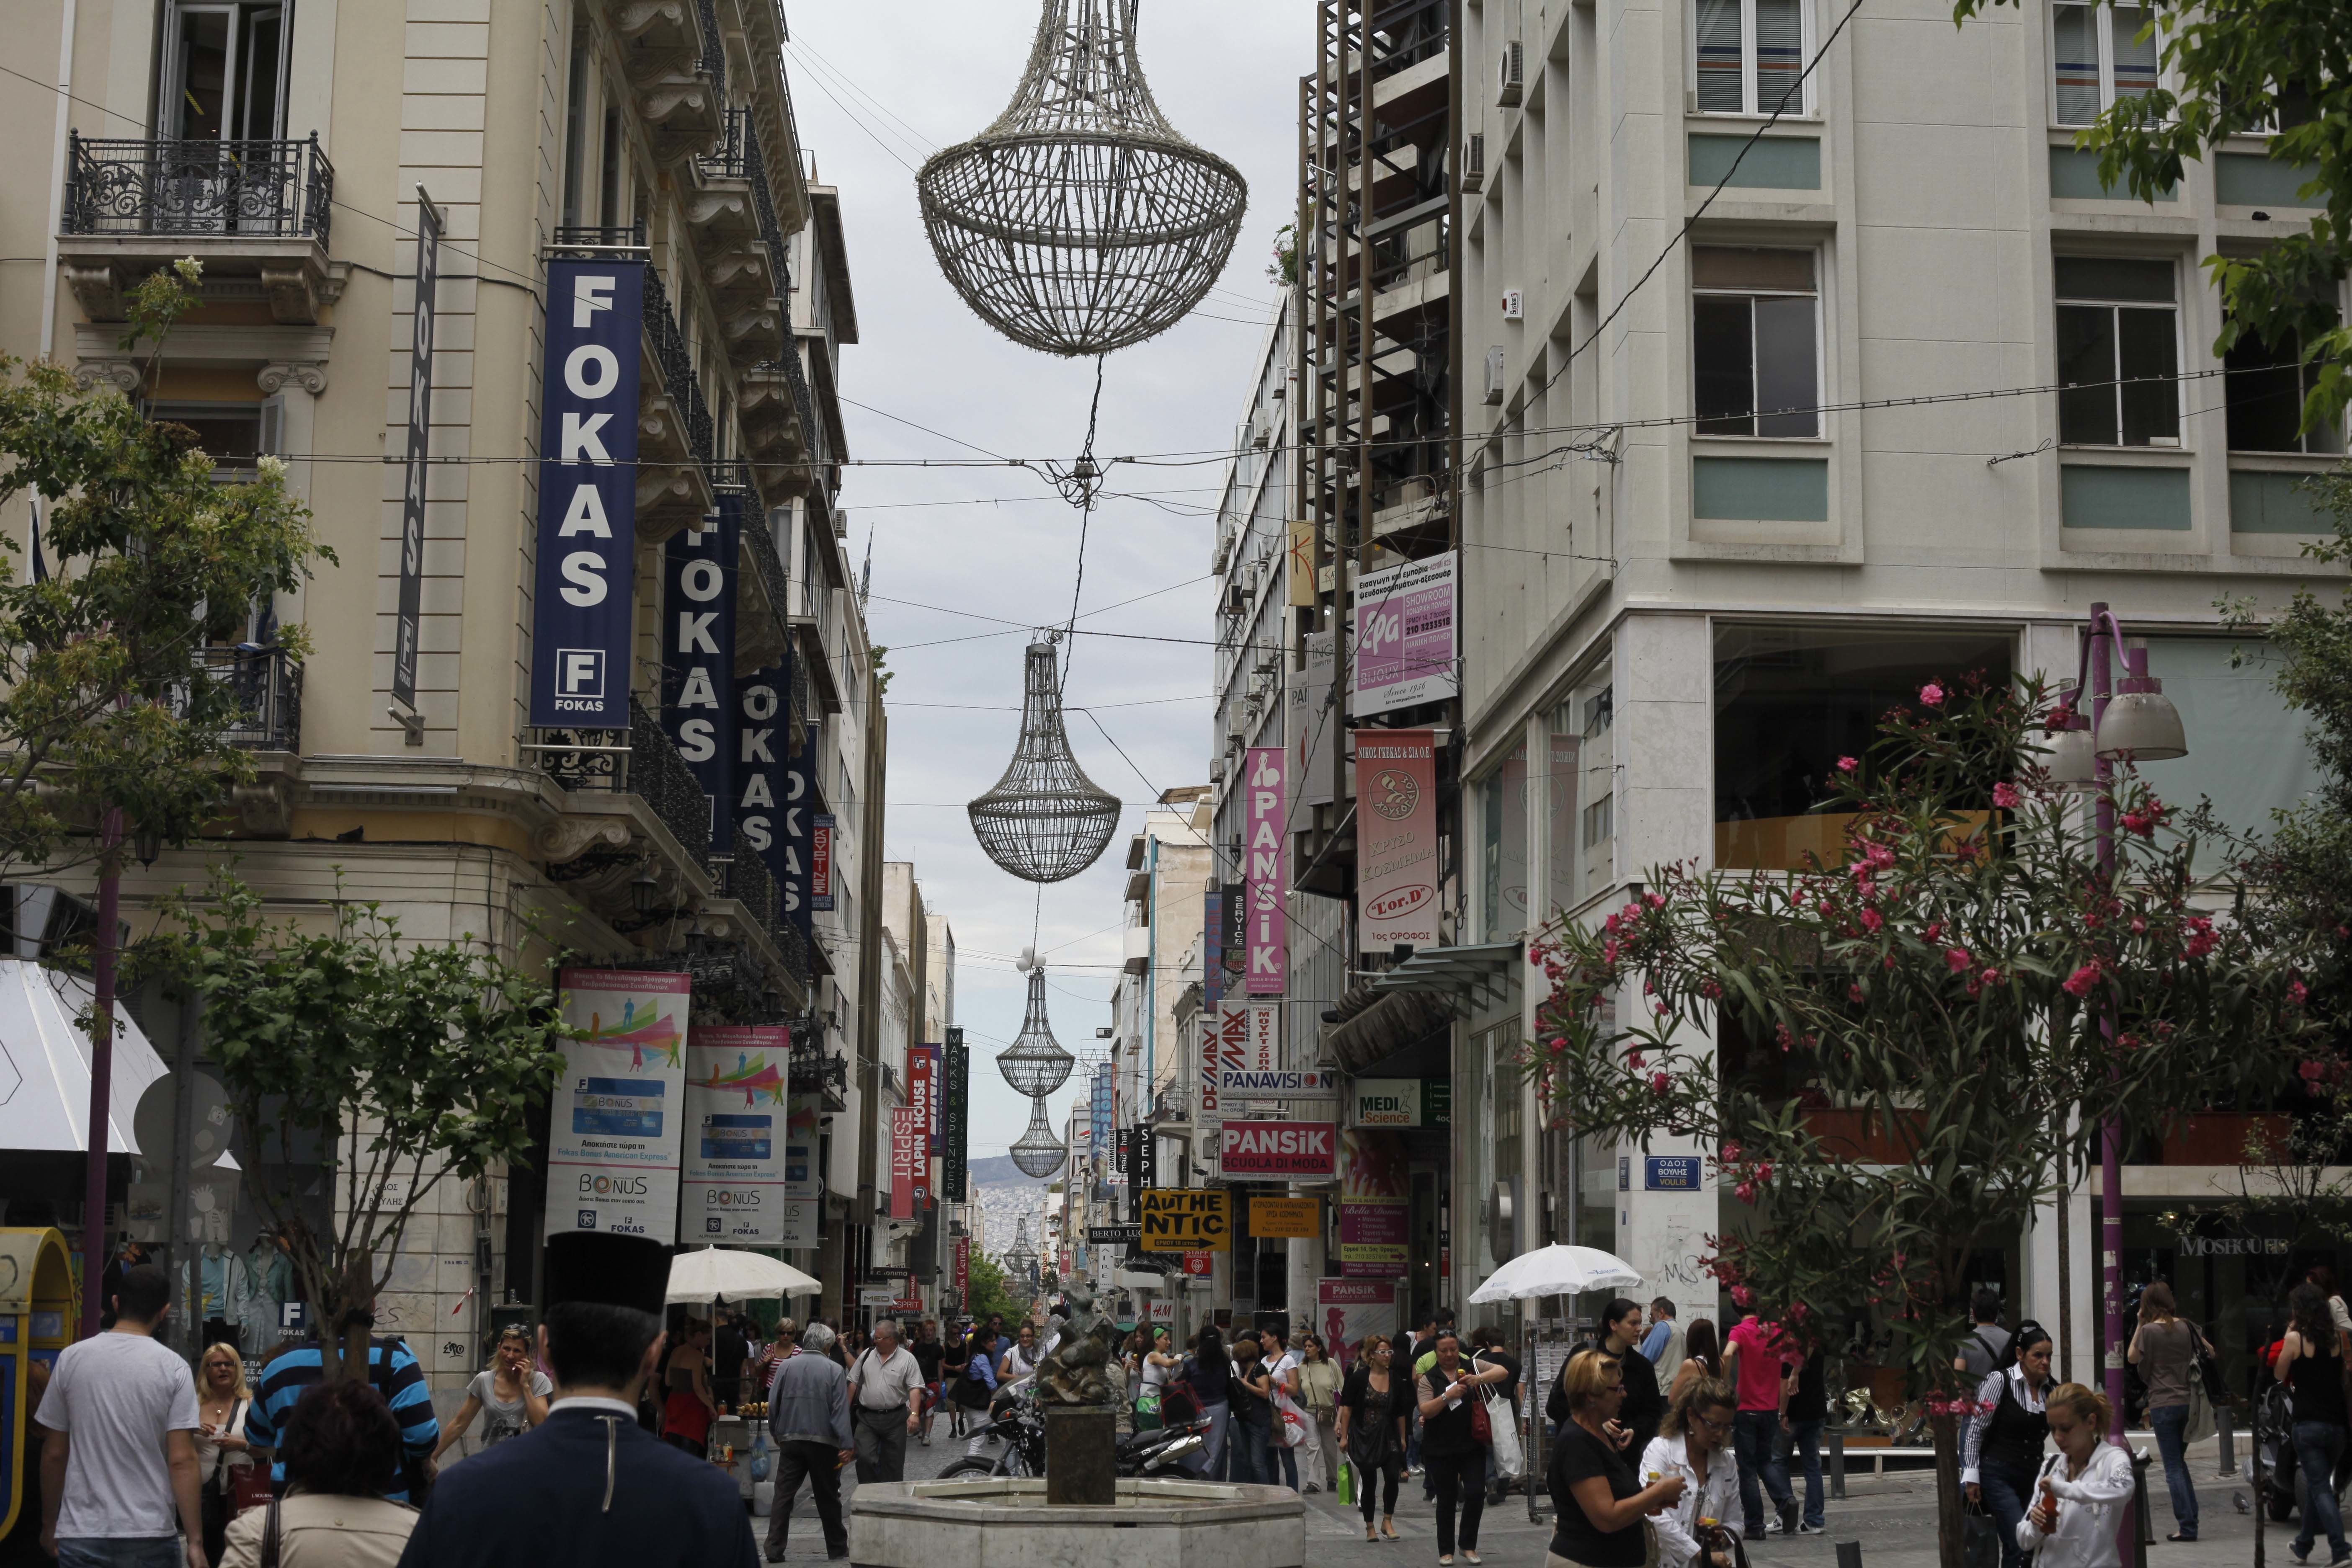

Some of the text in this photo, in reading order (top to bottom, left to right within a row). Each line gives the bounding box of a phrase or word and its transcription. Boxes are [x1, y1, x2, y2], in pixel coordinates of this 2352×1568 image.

[407, 226, 432, 576] FOKAS
[558, 275, 619, 607] FOKAS
[1359, 575, 1390, 589] Εισαγωγή
[1403, 566, 1428, 580] εμπορία
[1406, 586, 1450, 609] SHOWROOM
[1406, 599, 1451, 617] ΧΟΝΔΡΙΚΗ ΠΩΛΗΣΗ
[1406, 616, 1421, 625] ΕΡΜΟΥ
[1406, 617, 1451, 635] 210 3233518
[403, 624, 411, 664] F
[1406, 631, 1451, 649] ΛΙΑΝΙΚΗ ΠΩΛΗΣΗ
[400, 669, 410, 687] FOKAS
[566, 654, 593, 691] F
[1383, 681, 1427, 698] Since 1956
[555, 699, 604, 712] FOKAS
[1359, 747, 1431, 759] ΝΙΚΟΣ ΓΚΕΚΑΣ & ΣΙΑ Ο.Ε.
[740, 684, 778, 852] OKAS
[1369, 830, 1416, 858] ΧΡΥΣΟ
[1361, 845, 1435, 883] ΚΟΣΜΗΜΑ
[1235, 895, 1243, 945] SERVICE
[1372, 933, 1386, 941] 1ος
[643, 975, 676, 983] Πρόγραμμα
[1223, 1072, 1333, 1090] PANAVISION
[947, 1034, 959, 1191] MARKS & SPENCER
[1359, 1097, 1398, 1119] MEDI
[913, 1079, 925, 1176] LAPIN HOUSE
[581, 1140, 617, 1149] Αποκτήστε
[619, 1142, 637, 1151] τώρα
[894, 1111, 912, 1180] ESPRIT
[580, 1149, 602, 1158] Bonus
[603, 1150, 638, 1159] American
[640, 1152, 668, 1162] Express
[1140, 1129, 1151, 1188] SEPH
[1223, 1157, 1327, 1169] SCUOLA DI MODA
[369, 1197, 403, 1206] ΒΥΛΗΣ
[1344, 1206, 1403, 1215] Bella Donna
[611, 1225, 645, 1233] FOKAS
[956, 1243, 966, 1275] Center
[283, 1302, 301, 1326] F
[1141, 1447, 1151, 1456] GS
